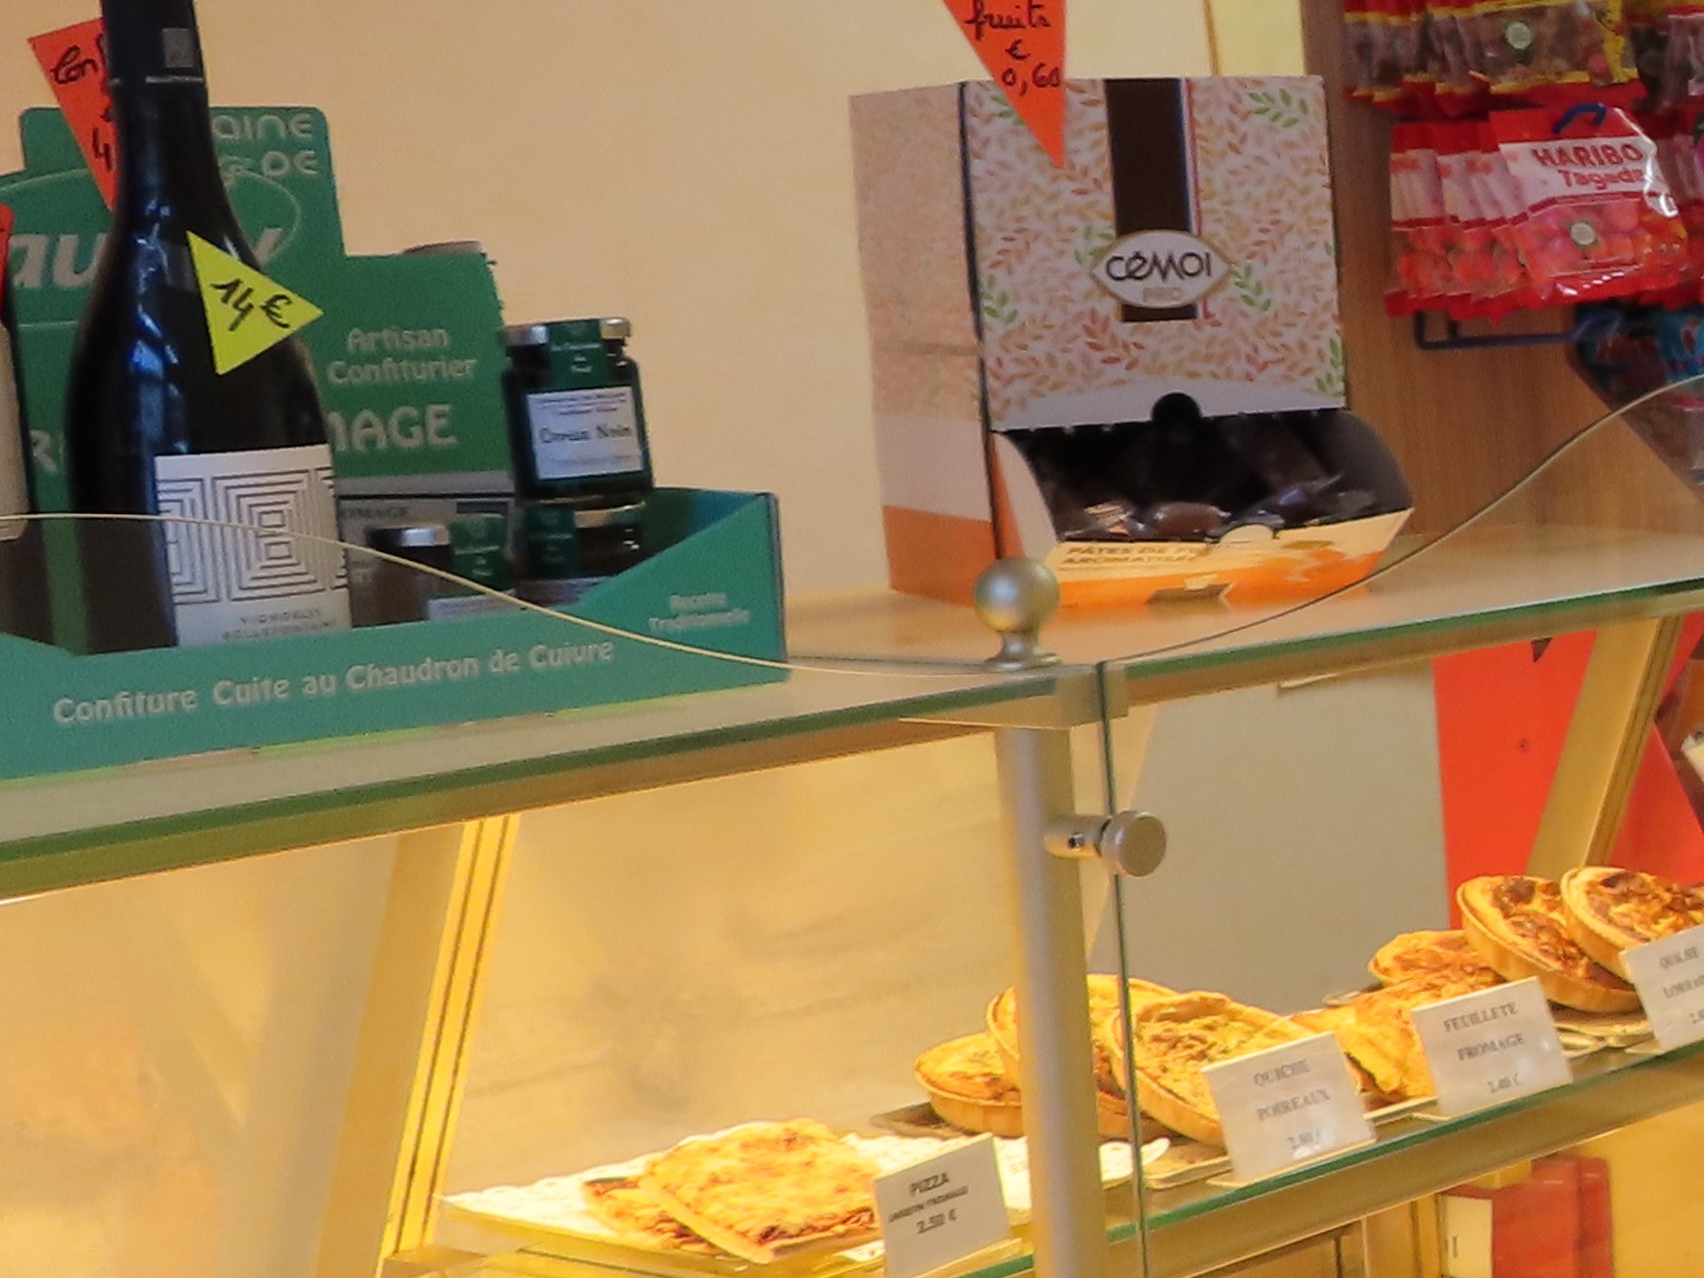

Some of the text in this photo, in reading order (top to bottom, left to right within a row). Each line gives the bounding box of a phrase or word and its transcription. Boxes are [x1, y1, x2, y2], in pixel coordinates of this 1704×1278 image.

[1531, 140, 1644, 168] HARIBO
[347, 327, 451, 352] Artisan
[327, 356, 477, 385] Confiturier
[53, 639, 616, 727] Confiture Cuite au Chaudron de Cuivre
[1443, 1001, 1519, 1034] FEUILLETE
[1456, 1032, 1526, 1062] FROMAGE
[1253, 1058, 1311, 1088] QUICHE
[1256, 1087, 1331, 1121] POIREAUX
[908, 1172, 949, 1197] PIZZA
